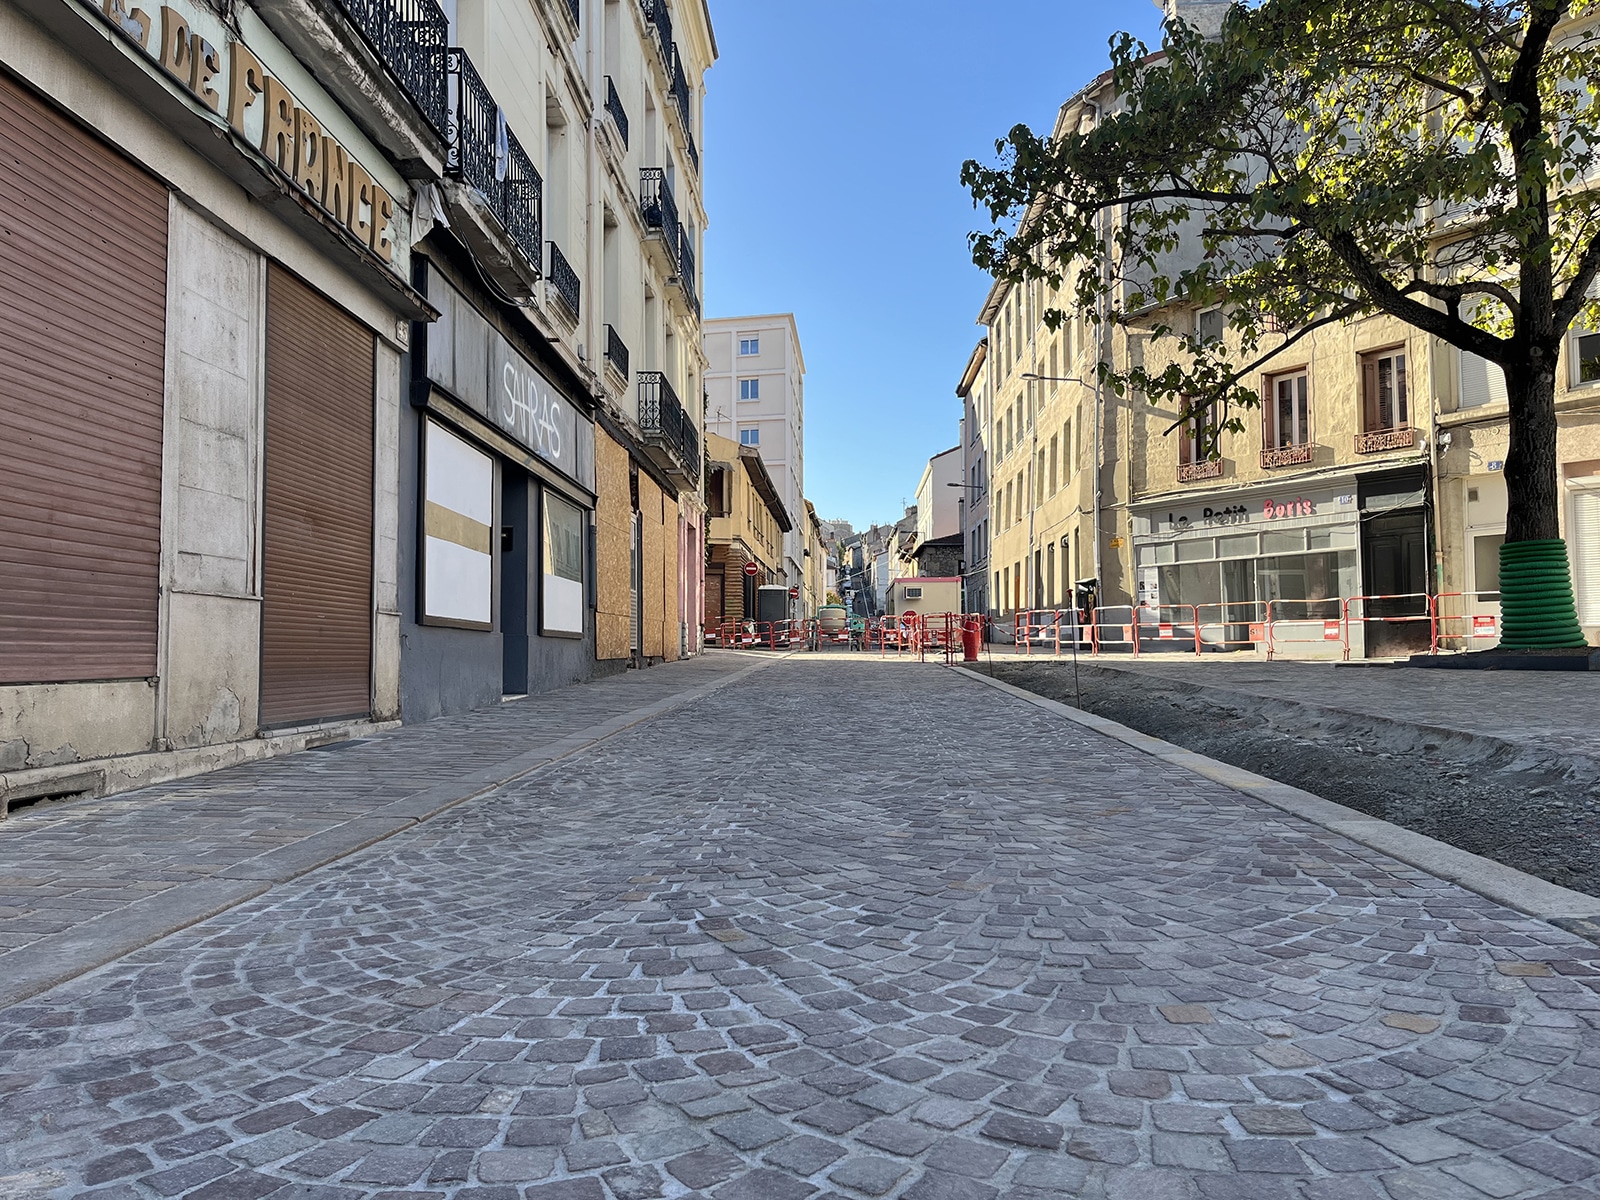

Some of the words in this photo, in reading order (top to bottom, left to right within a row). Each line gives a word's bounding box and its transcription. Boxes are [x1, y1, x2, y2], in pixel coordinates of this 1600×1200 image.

[160, 5, 220, 112] DE
[227, 42, 394, 264] FRANCE
[1168, 513, 1190, 530] Le
[1203, 505, 1248, 526] Petit
[1263, 496, 1312, 519] Boris
